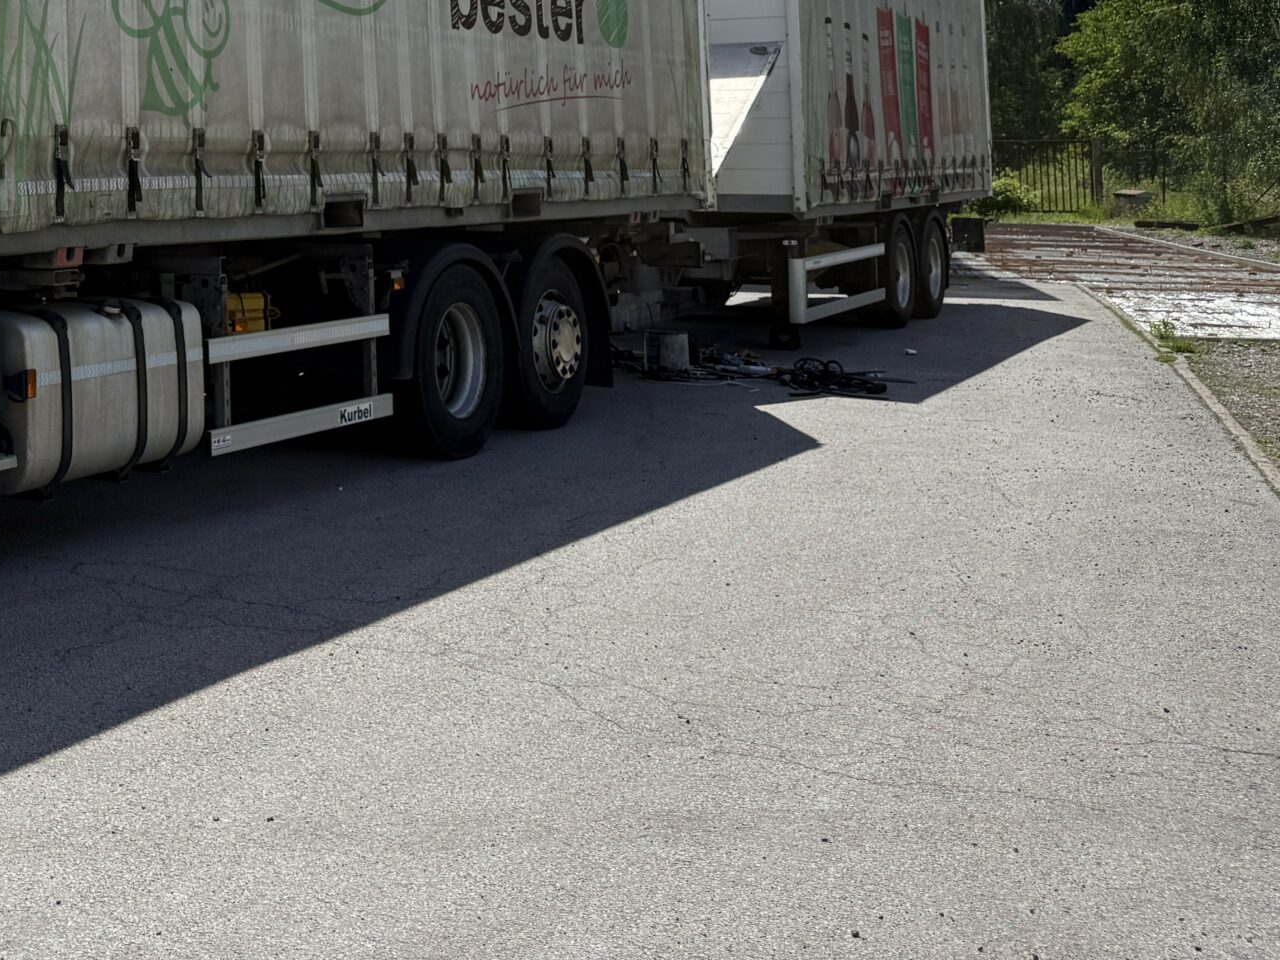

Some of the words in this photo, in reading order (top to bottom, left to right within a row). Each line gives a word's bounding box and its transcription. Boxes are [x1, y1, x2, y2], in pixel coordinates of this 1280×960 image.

[471, 63, 558, 105] natürlich
[562, 64, 588, 107] für
[594, 57, 632, 90] mich
[339, 403, 372, 425] Kurbel
